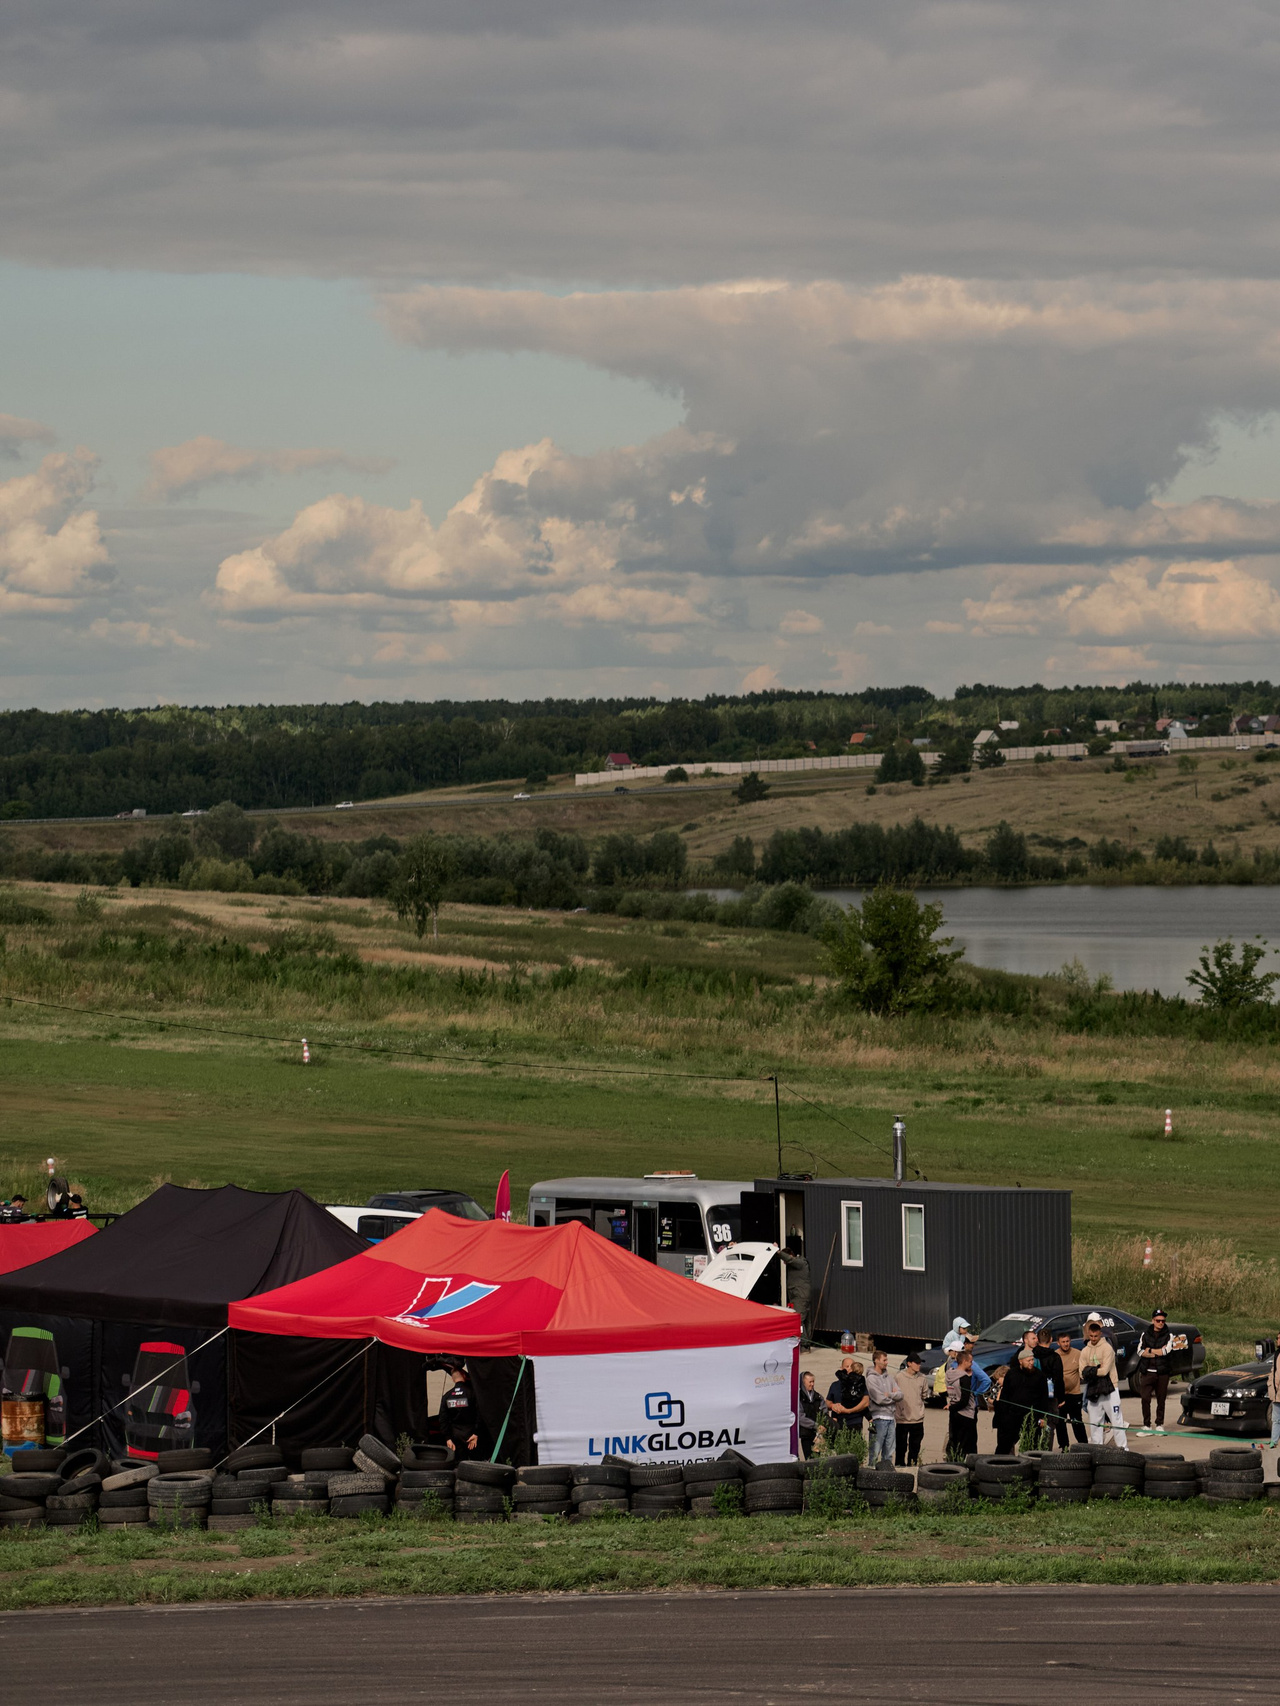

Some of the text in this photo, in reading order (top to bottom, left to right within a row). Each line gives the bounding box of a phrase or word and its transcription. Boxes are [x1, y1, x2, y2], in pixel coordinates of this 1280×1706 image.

[712, 1224, 732, 1242] 36
[754, 1375, 785, 1385] OMEGA
[588, 1428, 746, 1456] LINKGLOBAL
